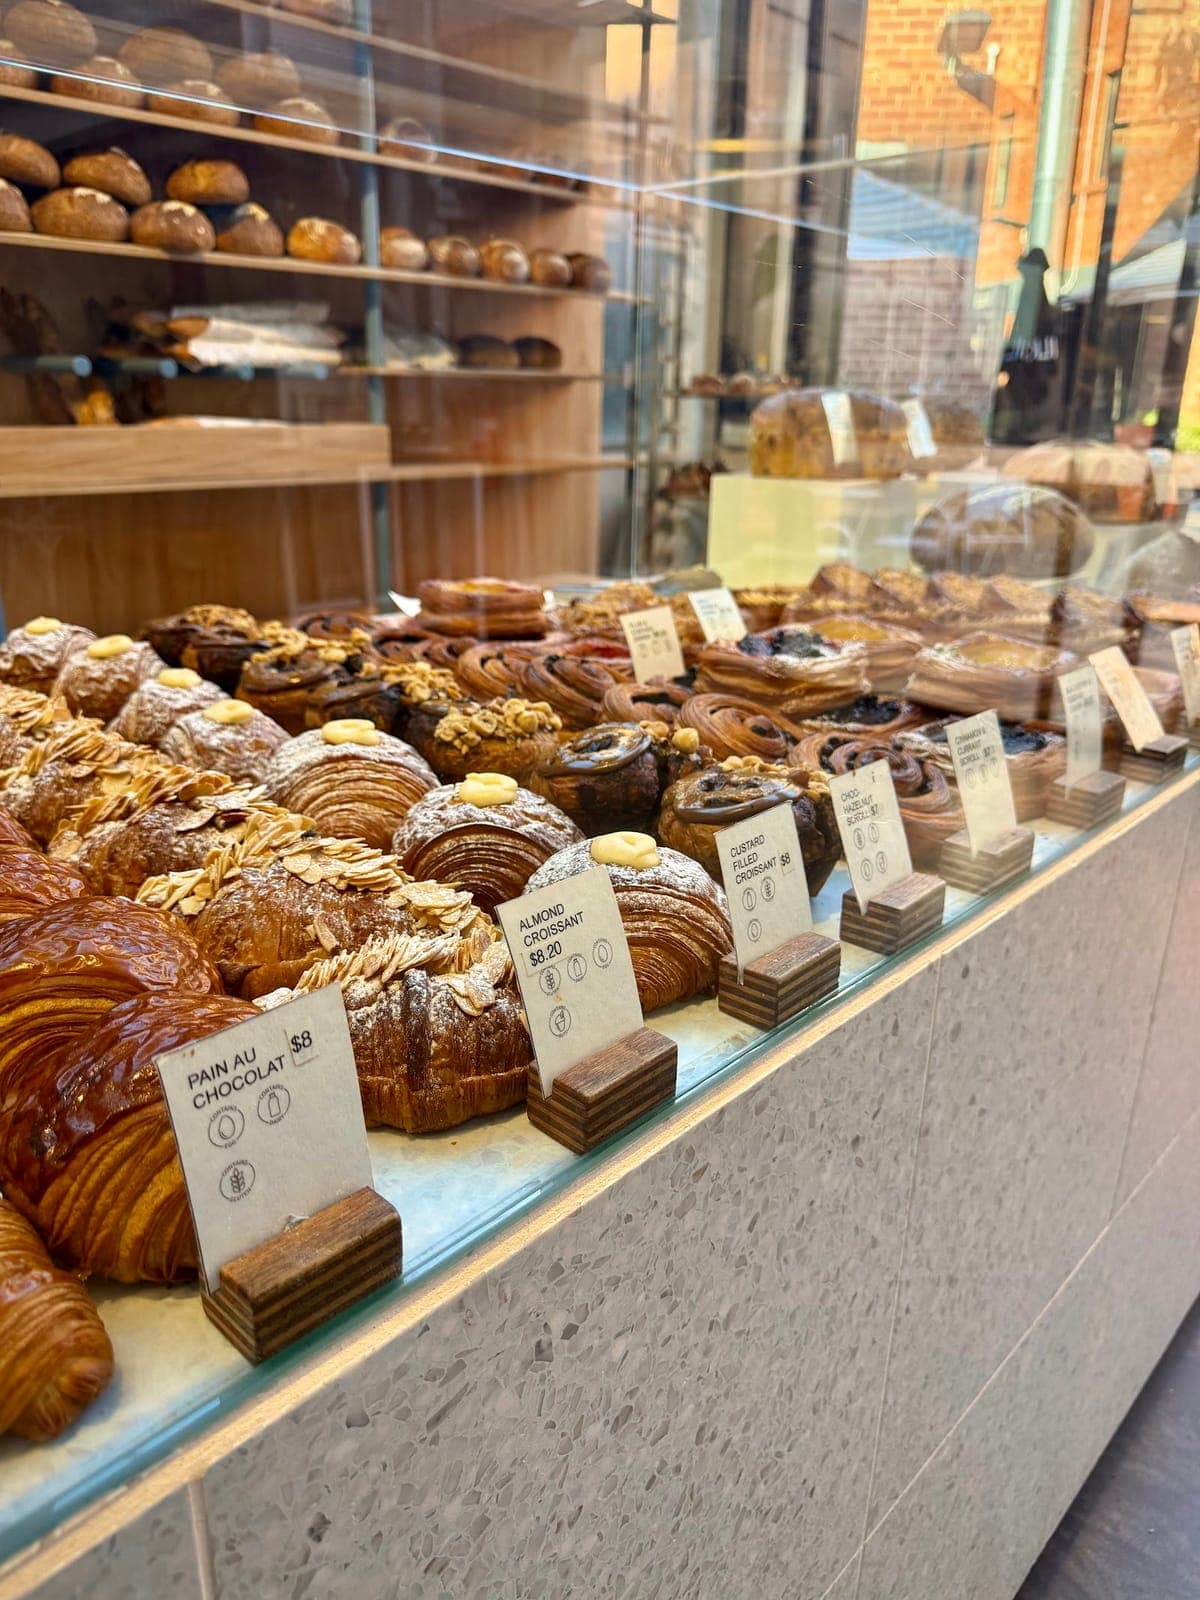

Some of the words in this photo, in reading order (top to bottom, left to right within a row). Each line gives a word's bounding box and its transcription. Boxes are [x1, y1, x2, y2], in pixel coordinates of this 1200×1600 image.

[843, 794, 872, 814] HAZELNUT
[847, 811, 870, 826] SCROLL
[730, 834, 765, 858] CUSTARD
[733, 852, 759, 872] FILLED
[735, 856, 777, 885] CROISSANT
[780, 852, 791, 867] $8
[519, 903, 565, 932] ALMOND
[524, 911, 584, 947] CROISSANT
[529, 940, 562, 968] $8.20
[290, 1030, 313, 1053] $8
[188, 1059, 228, 1090] PAIN
[233, 1048, 257, 1071] AU
[193, 1054, 285, 1110] CHOCOLAT
[210, 1105, 237, 1122] CONTAINS
[222, 1160, 249, 1176] CONTAINS
